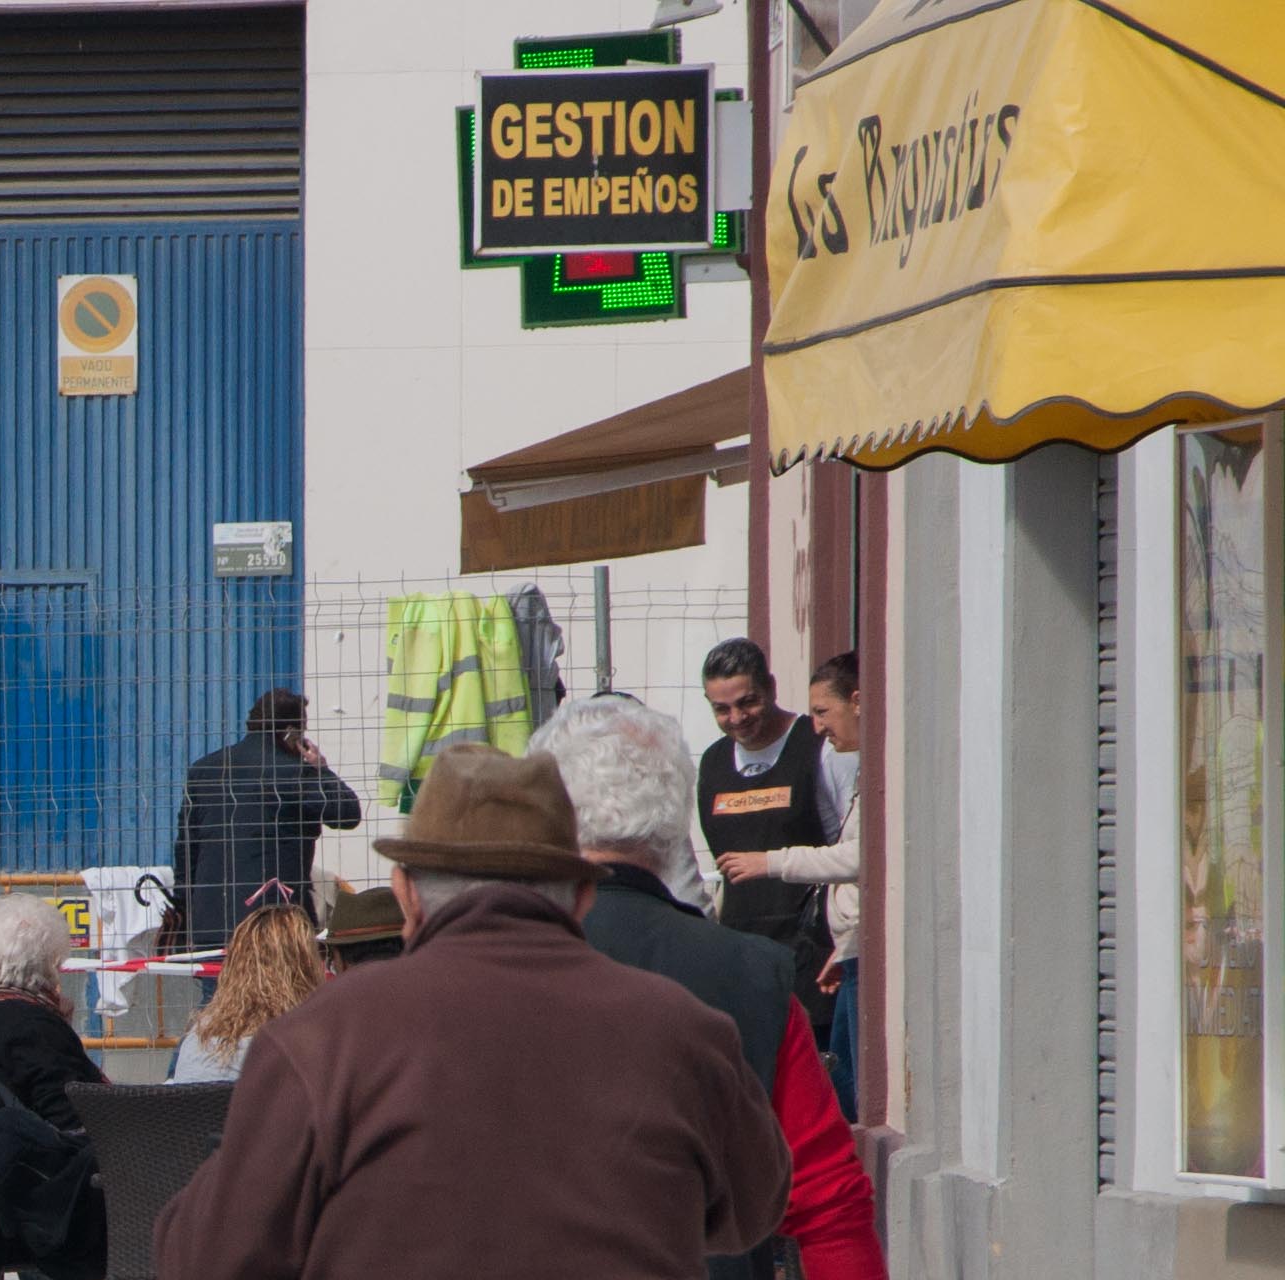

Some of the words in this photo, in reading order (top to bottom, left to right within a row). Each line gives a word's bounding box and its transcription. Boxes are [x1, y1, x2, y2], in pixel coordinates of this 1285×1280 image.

[490, 100, 695, 158] GESTION
[491, 179, 534, 217] DE
[543, 167, 699, 216] EMPEÑOS
[79, 359, 113, 371] VADO
[62, 375, 133, 388] PERMANENTE
